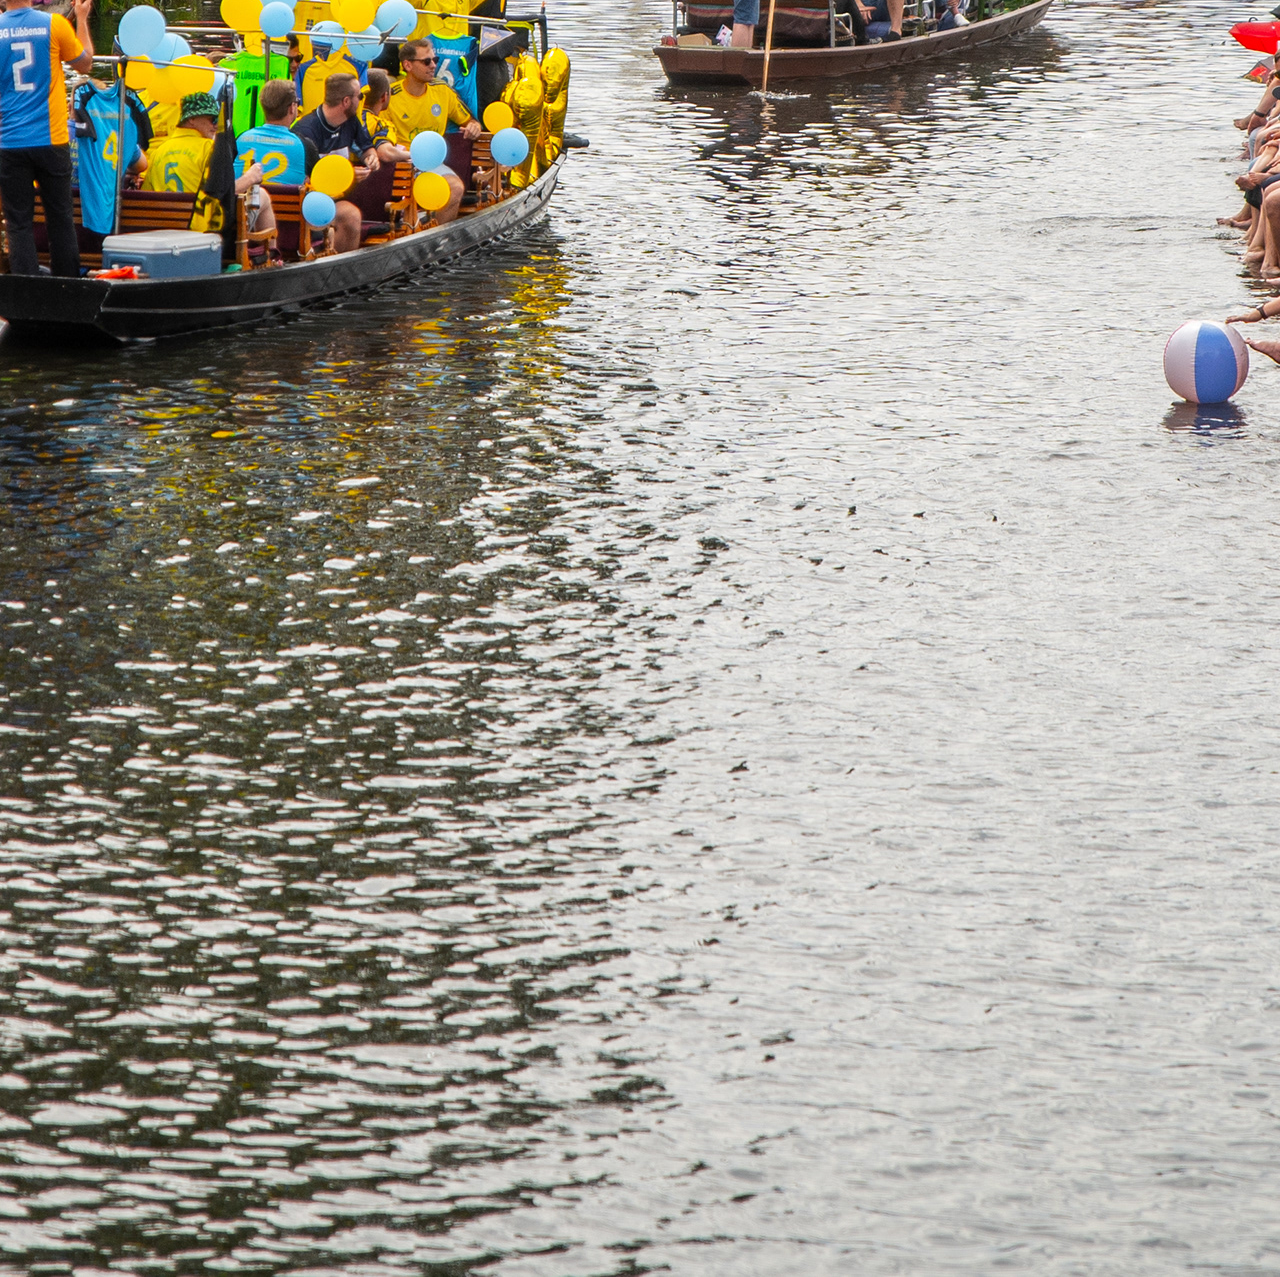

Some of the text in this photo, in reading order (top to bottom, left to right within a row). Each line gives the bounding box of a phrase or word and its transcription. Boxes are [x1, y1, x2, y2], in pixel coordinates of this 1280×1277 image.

[10, 26, 47, 37] Lübbenau
[11, 41, 35, 91] 2
[436, 58, 455, 88] 6
[102, 129, 119, 170] 4
[164, 162, 183, 192] 5
[239, 149, 288, 185] 12
